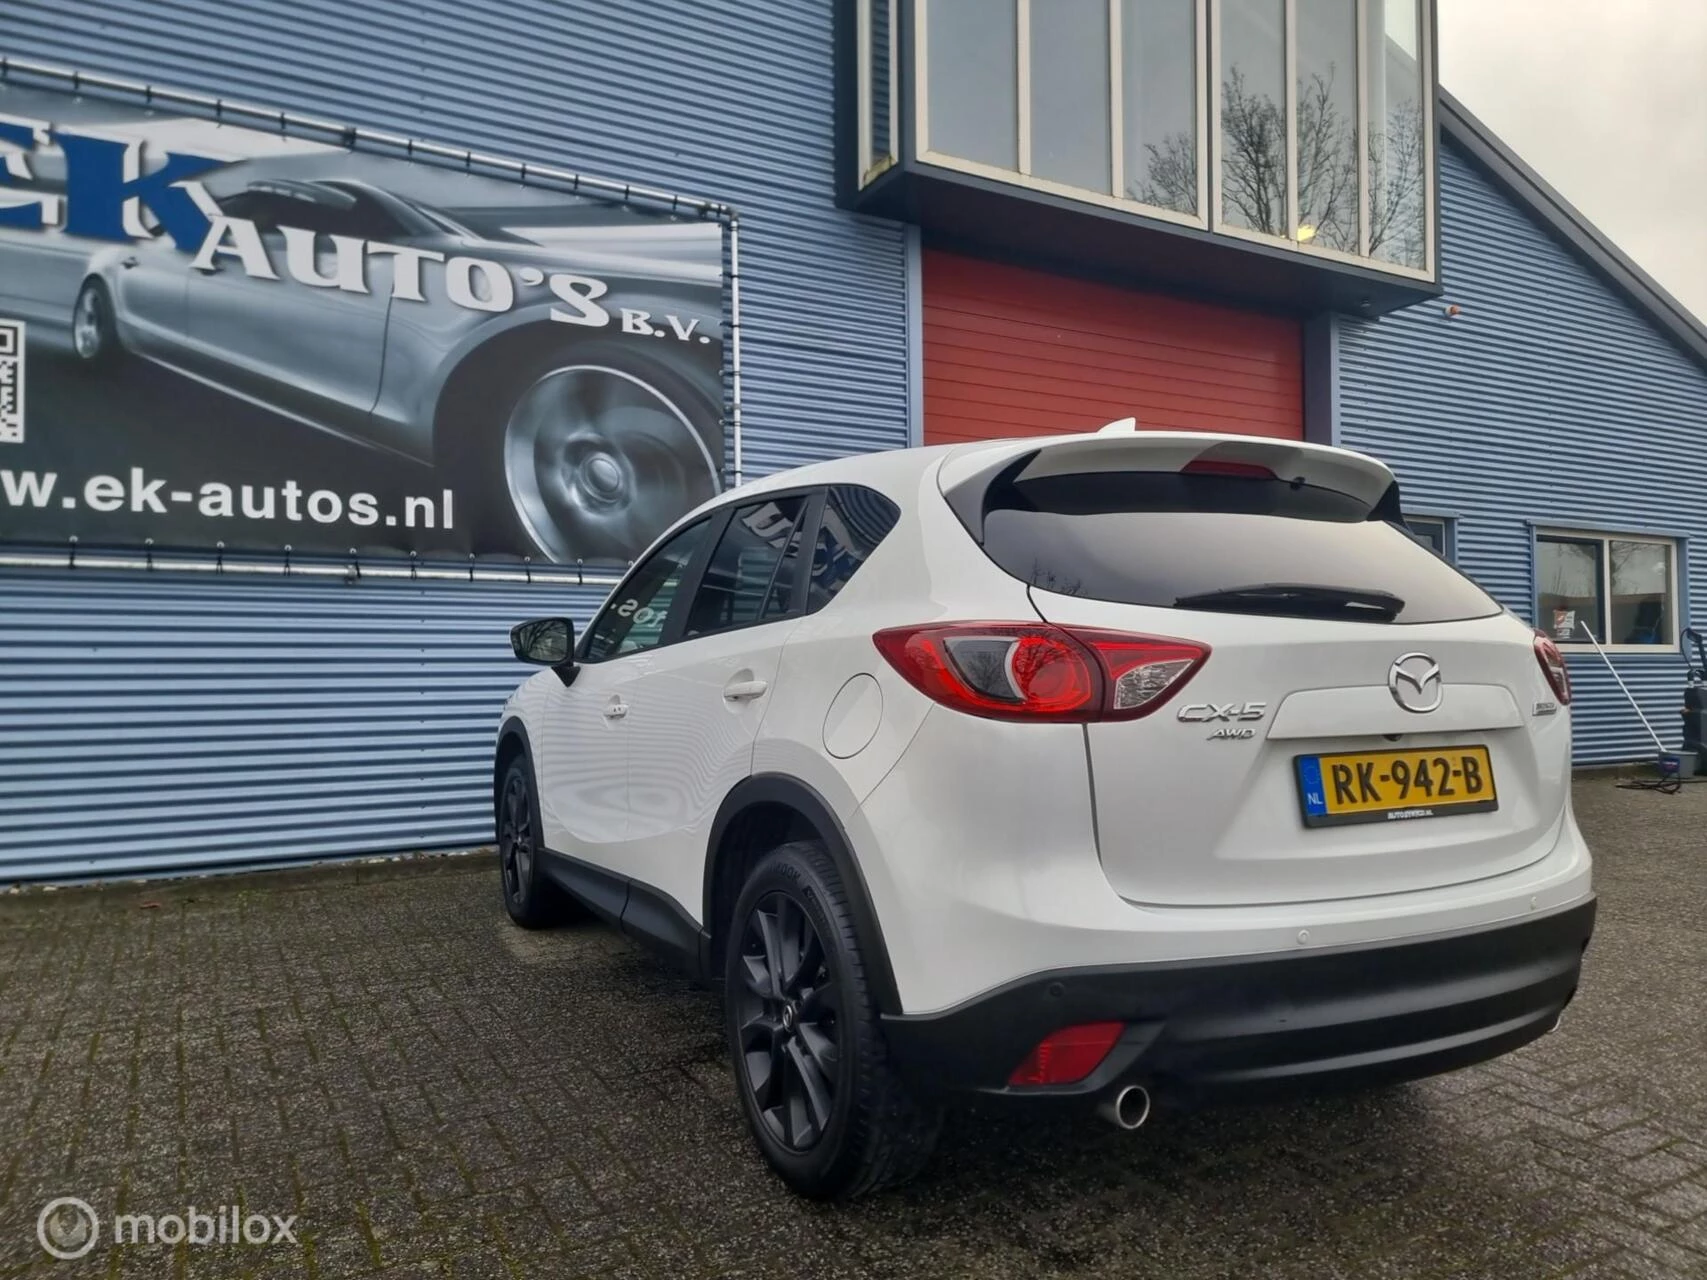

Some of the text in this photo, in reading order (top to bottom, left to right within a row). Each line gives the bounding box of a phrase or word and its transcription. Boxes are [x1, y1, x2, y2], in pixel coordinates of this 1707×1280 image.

[620, 307, 711, 344] B.V.
[1177, 701, 1267, 723] CX-5
[1206, 728, 1257, 741] AWD
[1331, 755, 1484, 806] RK-942-B
[1307, 792, 1323, 806] NL
